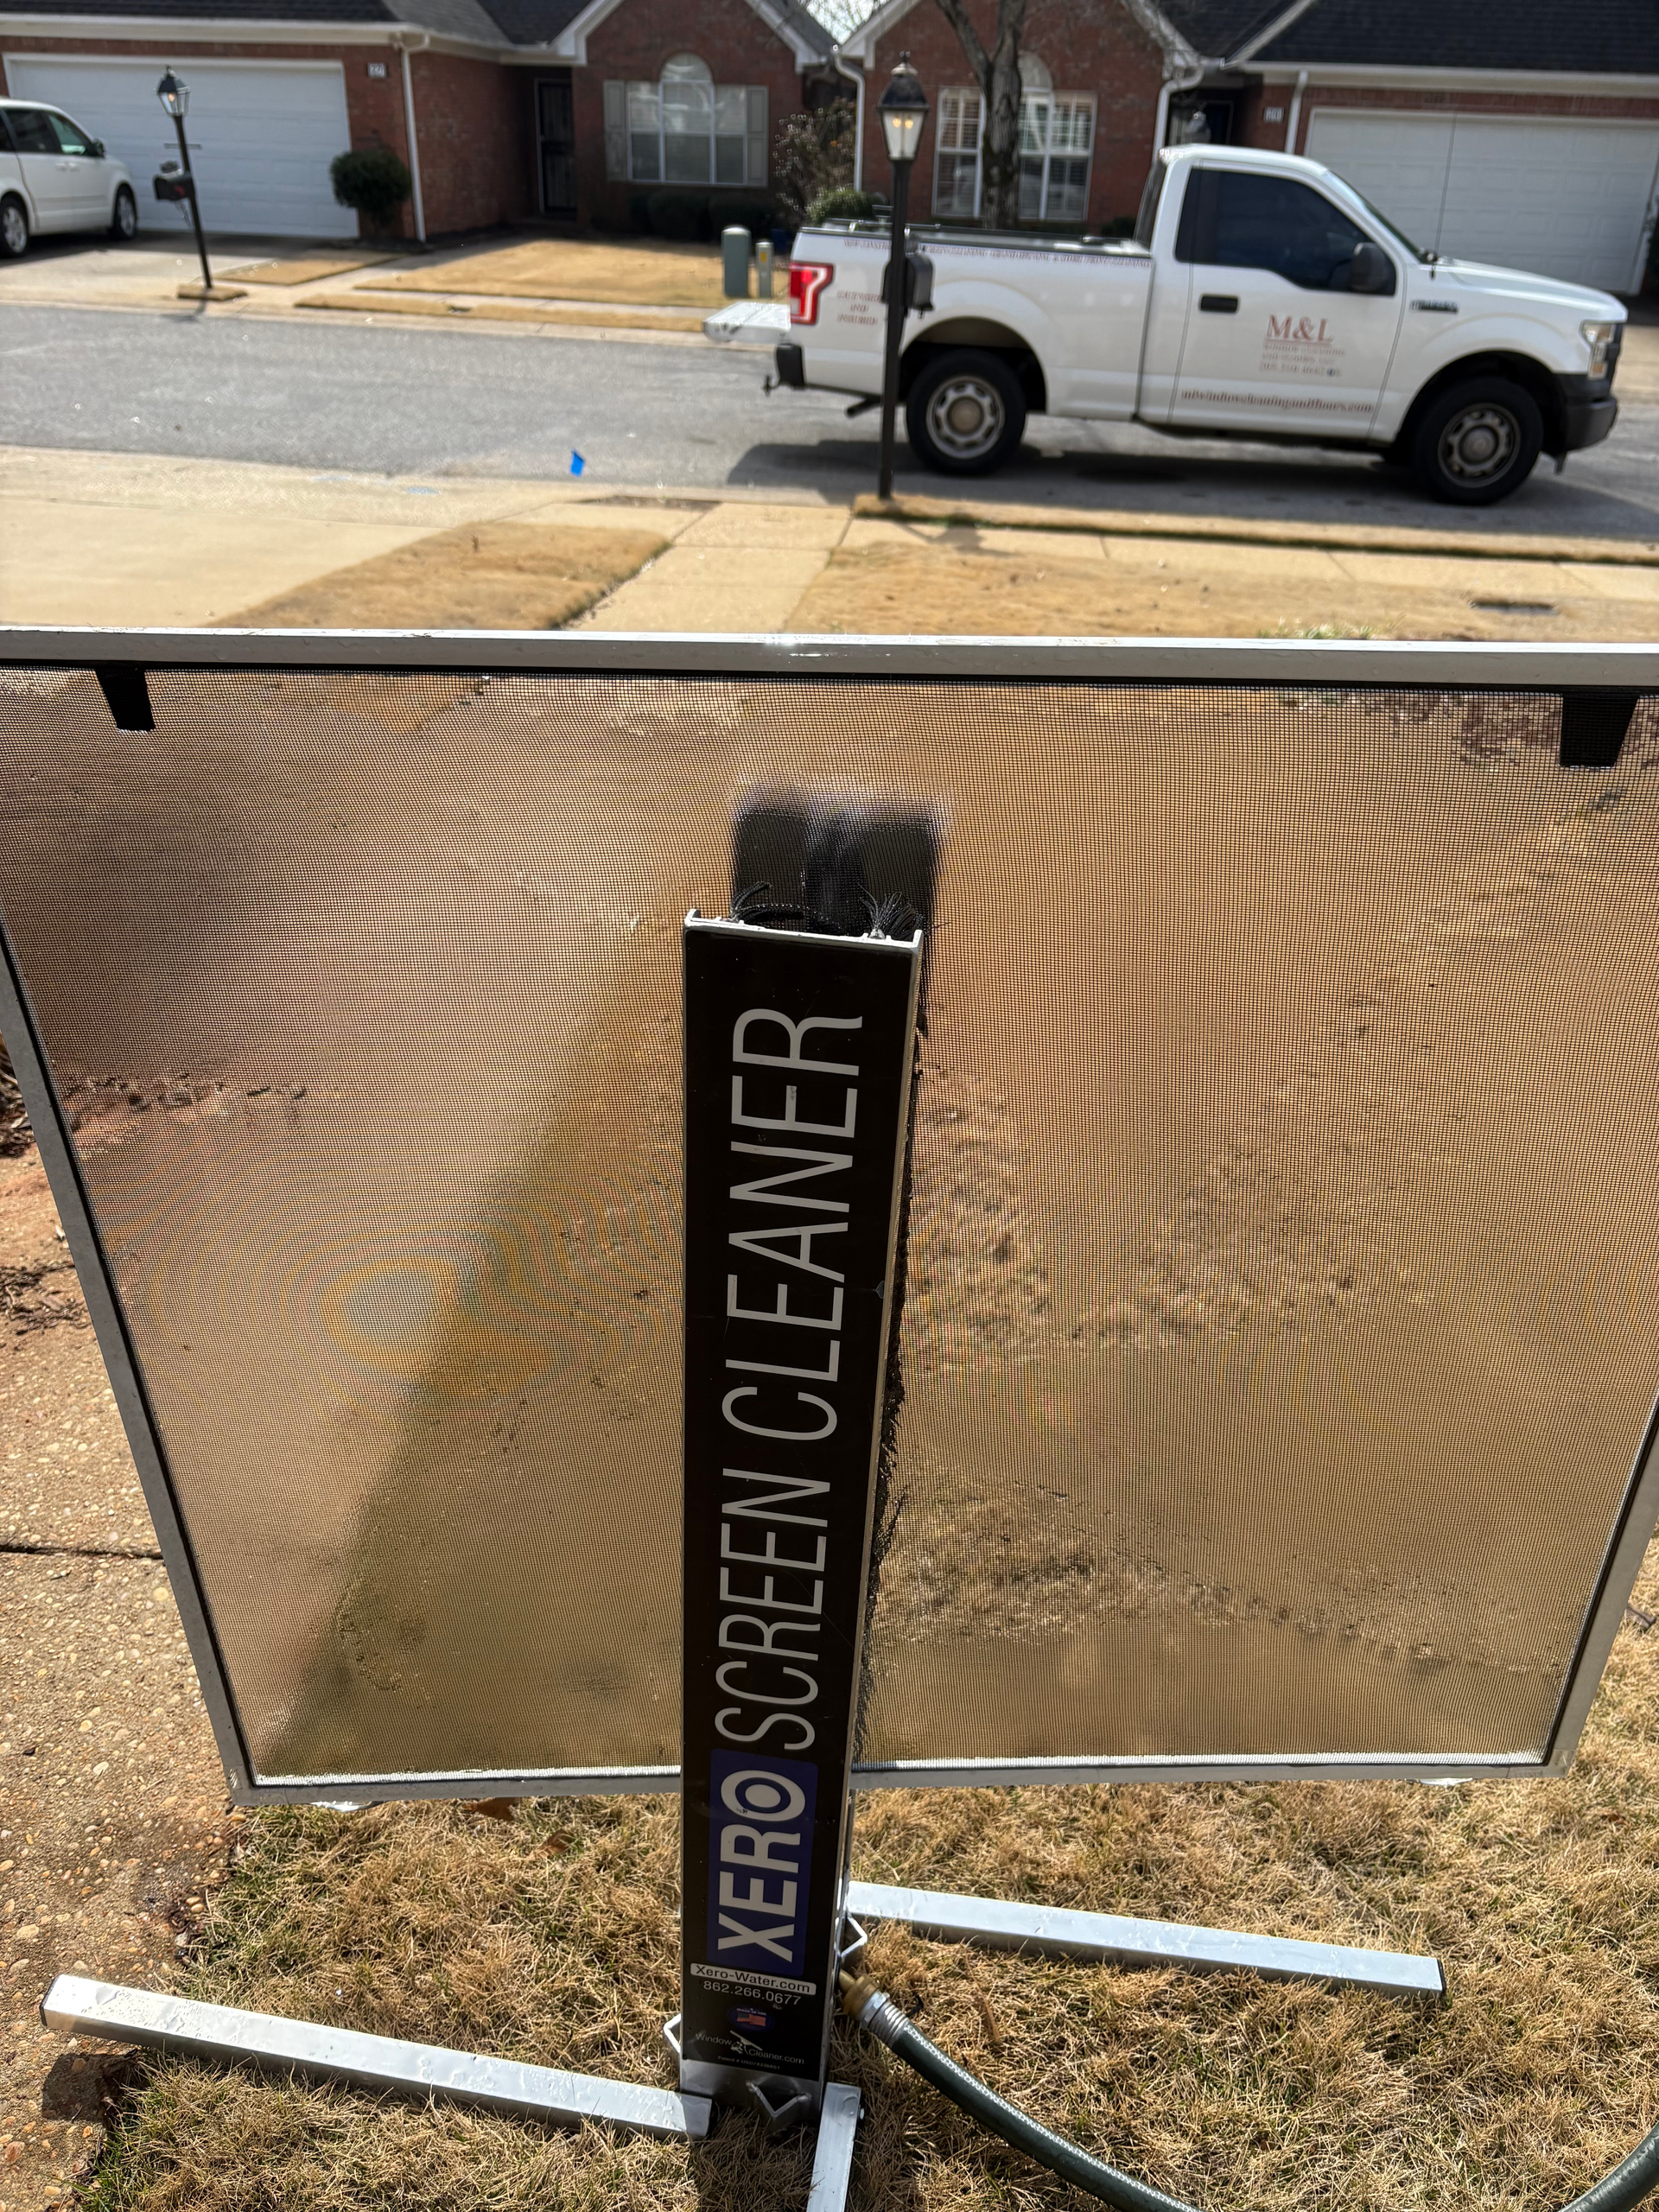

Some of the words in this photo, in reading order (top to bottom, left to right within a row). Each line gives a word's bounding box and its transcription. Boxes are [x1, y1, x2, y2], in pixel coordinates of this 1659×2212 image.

[1267, 314, 1333, 342] M&L
[721, 1007, 863, 1441] CLEANER
[715, 1467, 831, 1751] SCREEN
[717, 1769, 806, 1964] XERO
[696, 1964, 810, 1993] Xero-Water.com
[702, 1980, 801, 2005] 862.266.0677
[695, 2032, 733, 2046] Window
